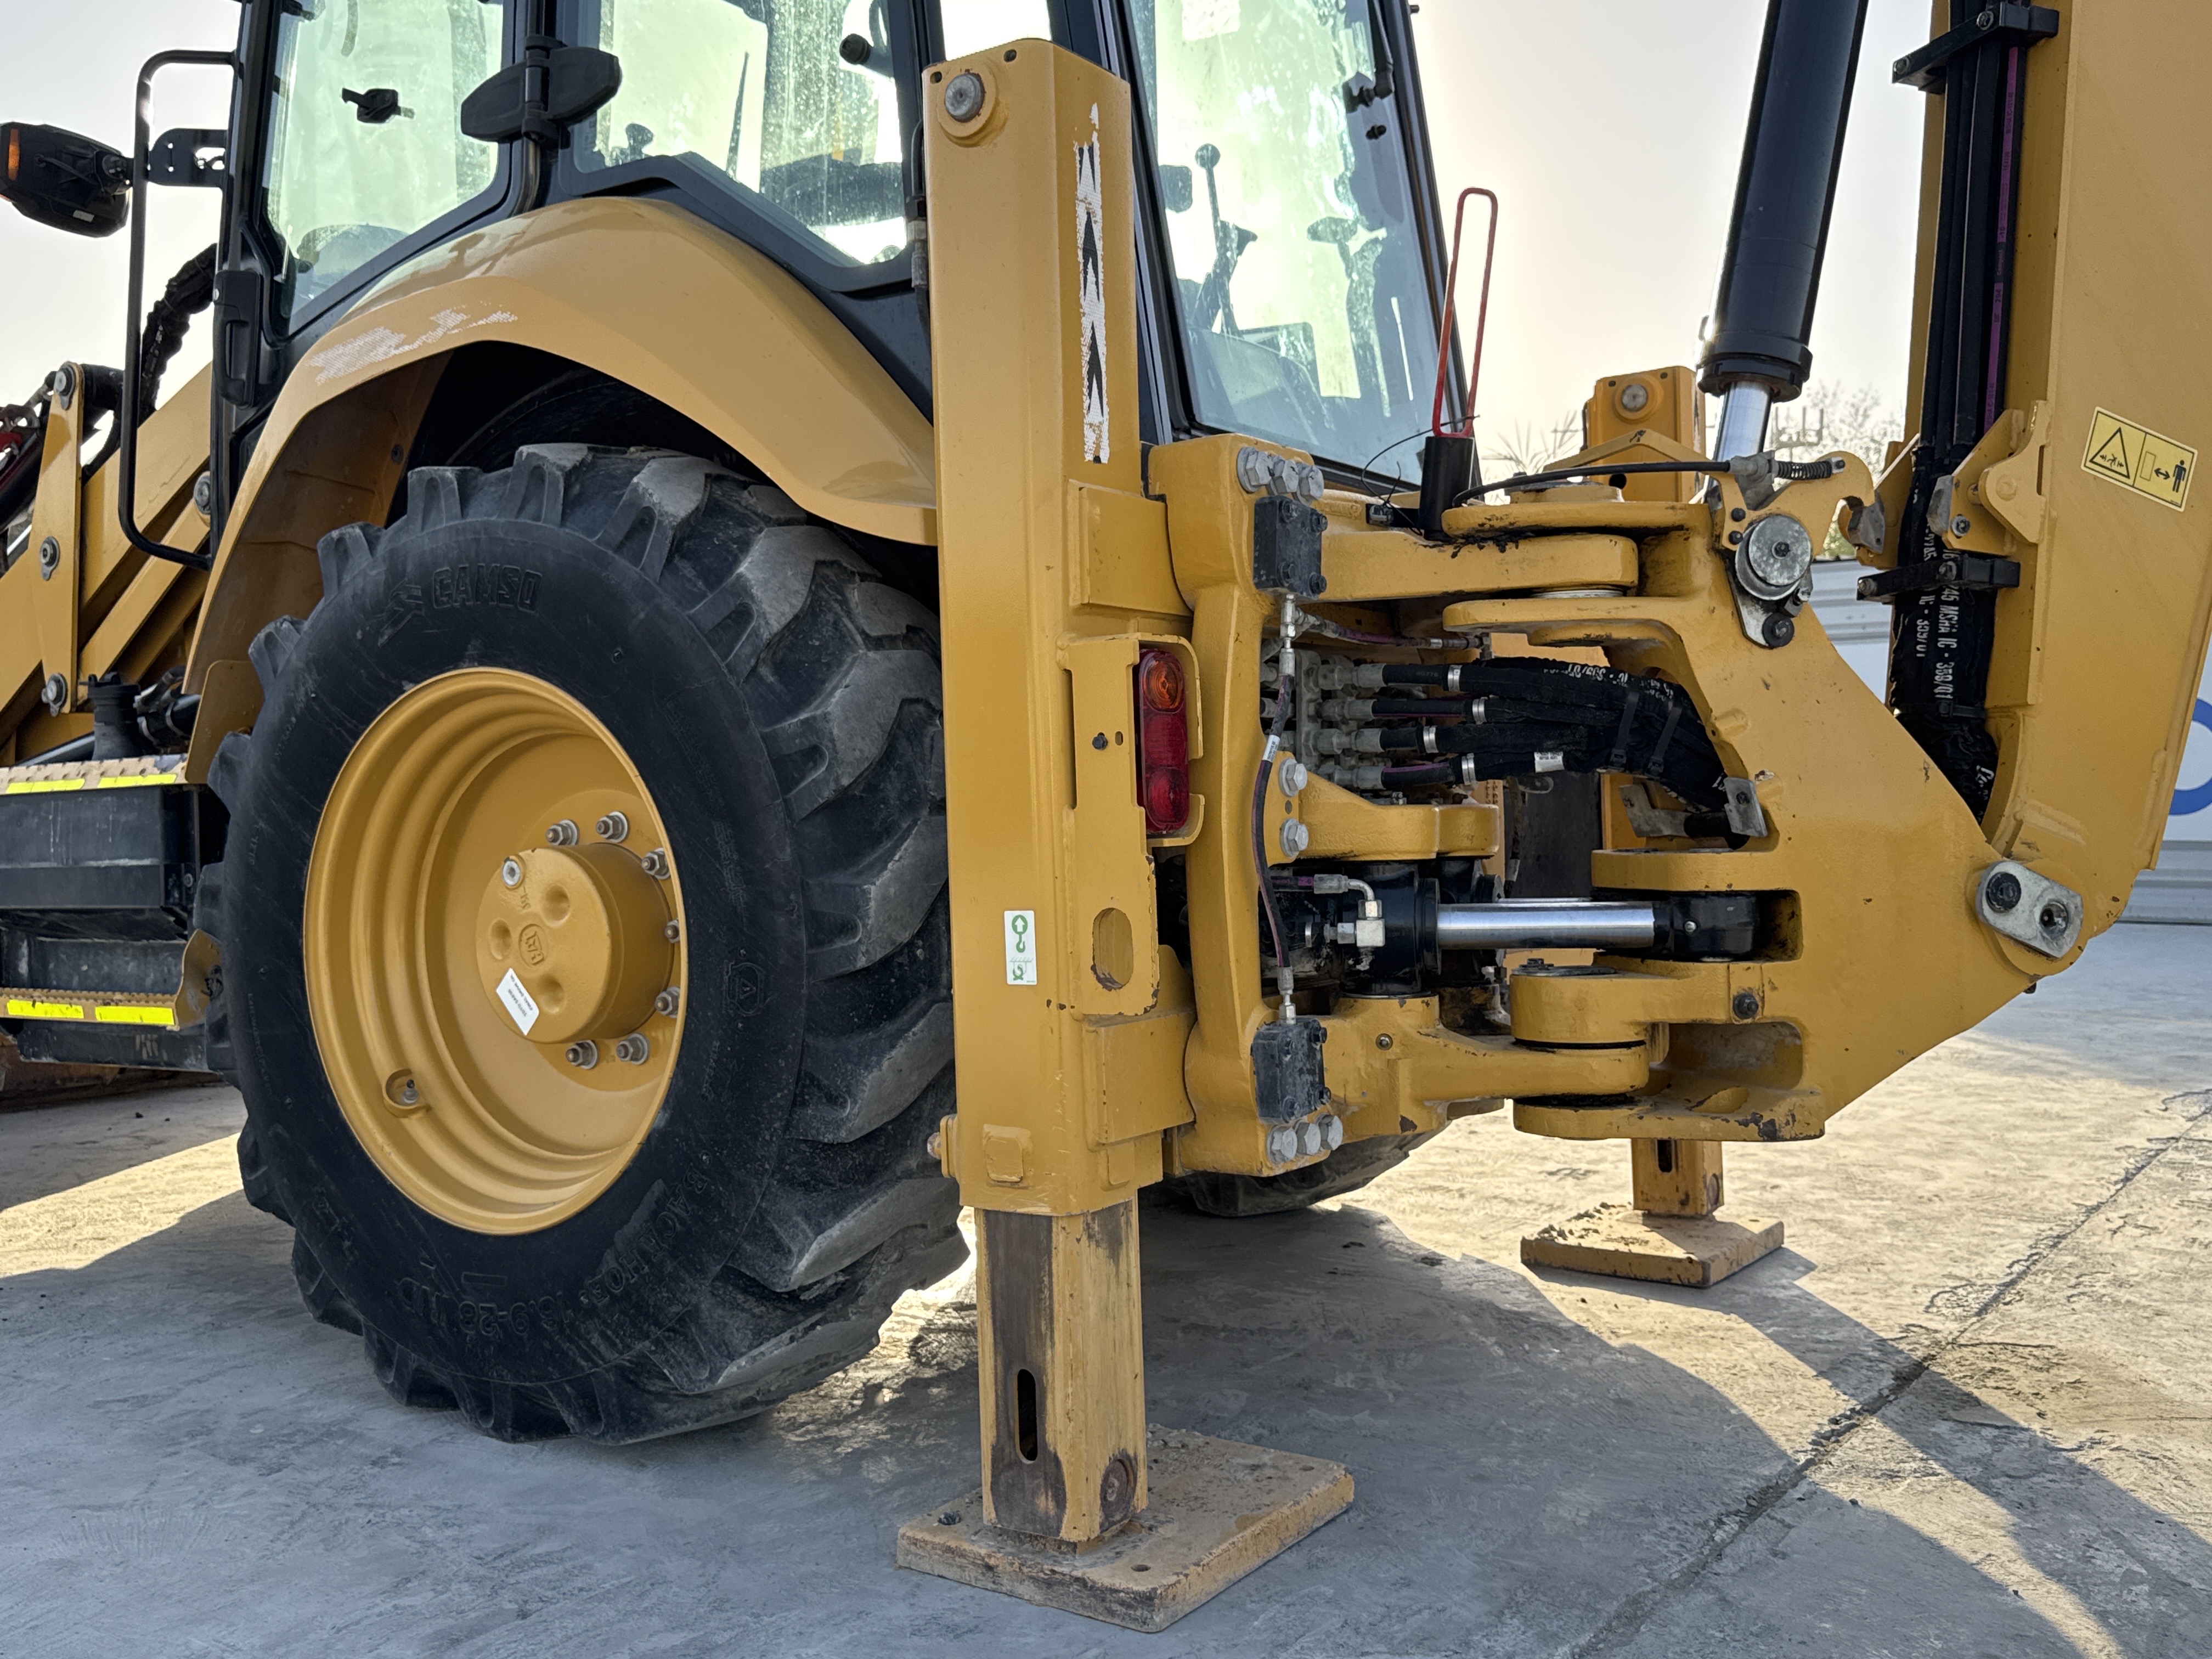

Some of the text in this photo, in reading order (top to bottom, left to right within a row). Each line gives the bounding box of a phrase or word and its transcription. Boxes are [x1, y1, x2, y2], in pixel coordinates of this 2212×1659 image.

[432, 563, 543, 613] CAMSO
[1937, 605, 1959, 633] MSHA
[1937, 638, 1957, 648] IC
